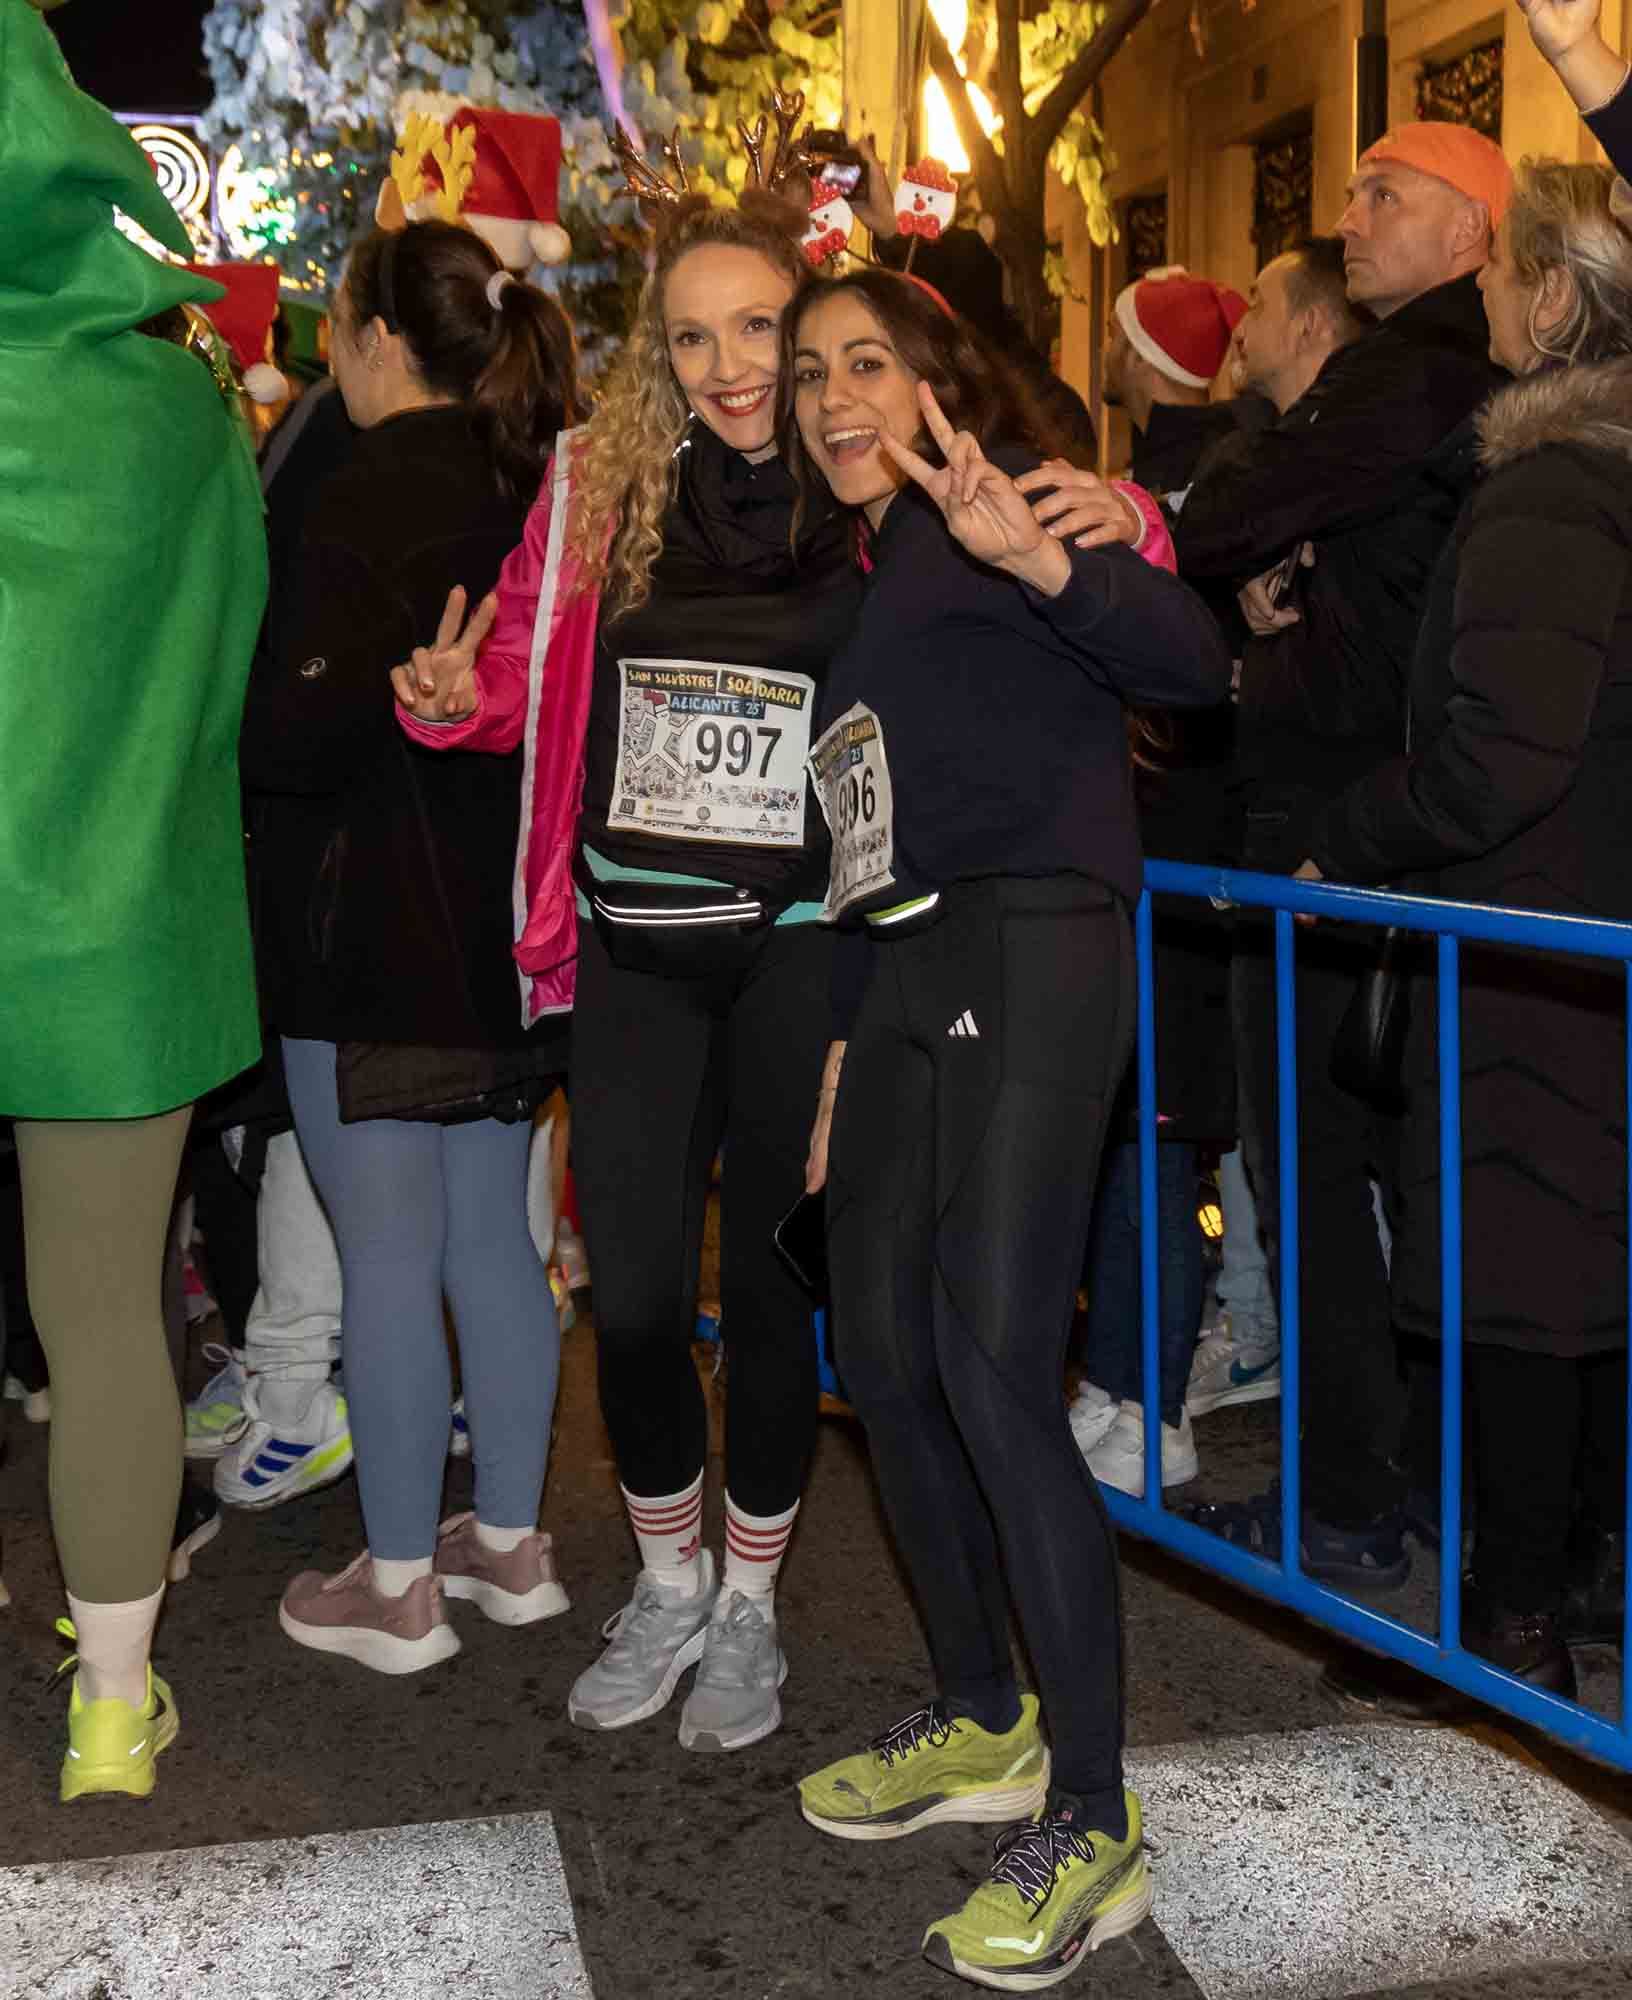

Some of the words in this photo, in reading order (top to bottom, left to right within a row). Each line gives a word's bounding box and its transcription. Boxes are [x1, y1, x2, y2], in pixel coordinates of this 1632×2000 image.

[628, 670, 650, 682] SAN
[655, 672, 715, 688] SILVESTRE
[727, 676, 801, 705] SOLIDARIA
[671, 697, 740, 714] ALICANTE
[695, 721, 782, 778] 997
[838, 765, 876, 837] 996
